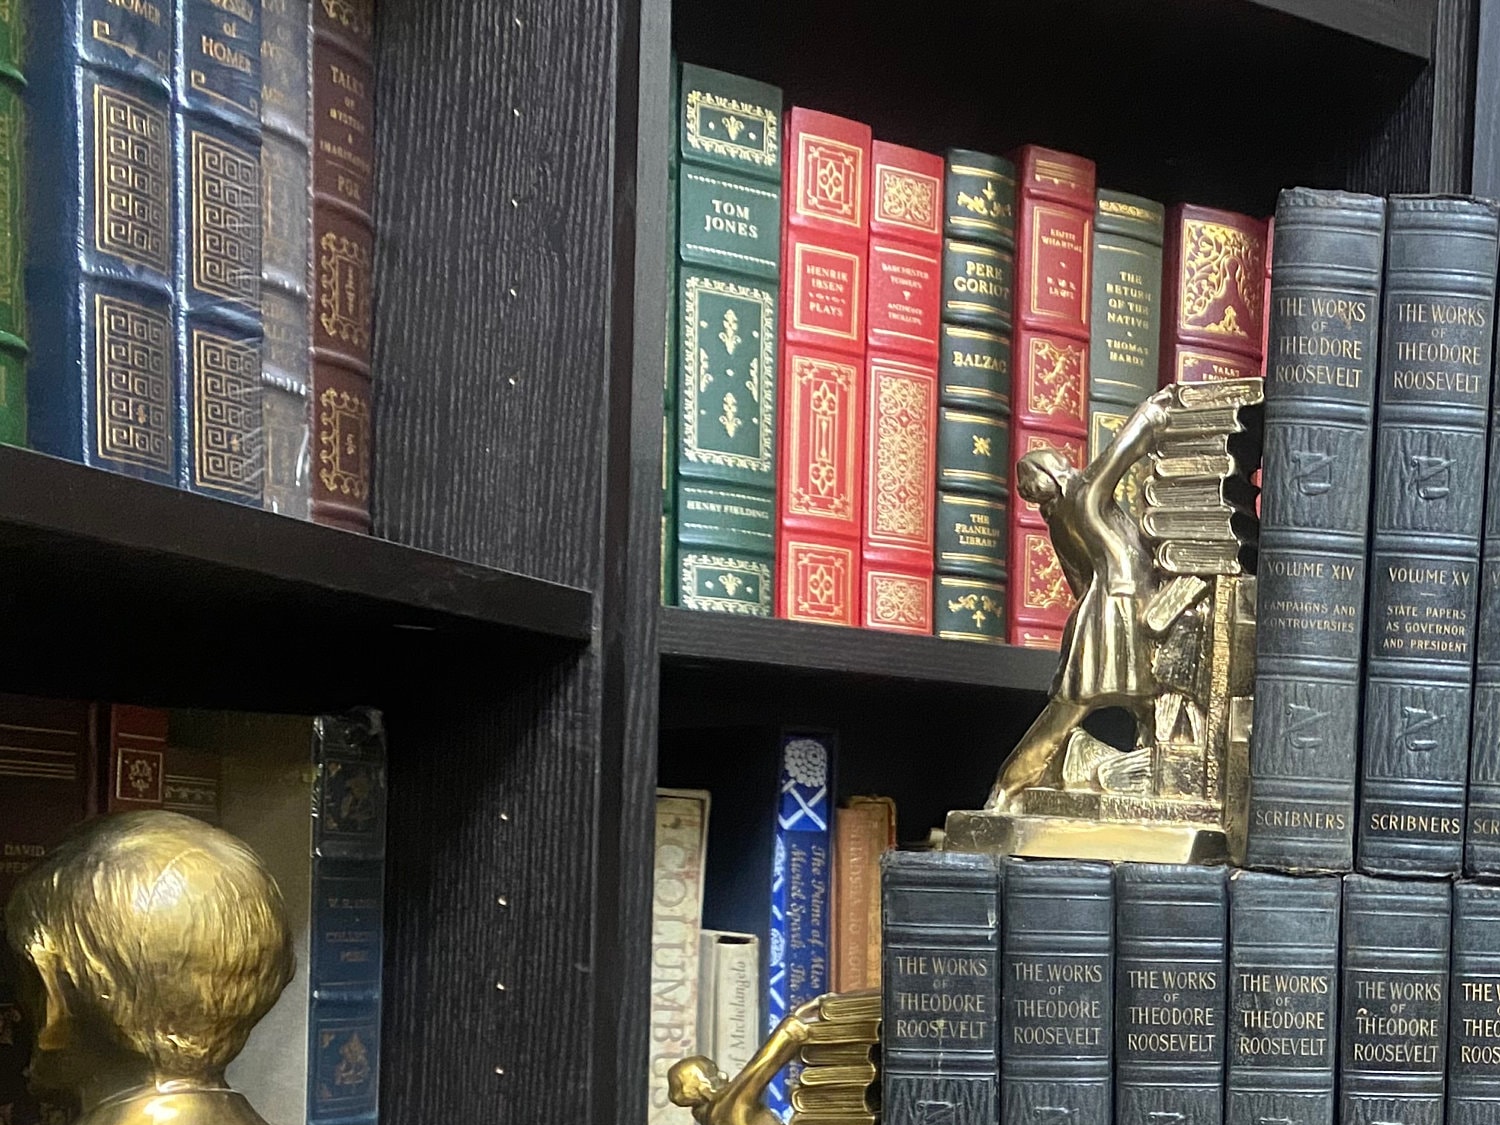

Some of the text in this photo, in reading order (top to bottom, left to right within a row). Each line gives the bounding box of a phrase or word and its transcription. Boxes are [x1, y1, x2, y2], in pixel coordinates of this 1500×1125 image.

[711, 199, 750, 220] TOM
[704, 214, 759, 239] JONES
[806, 264, 849, 281] HENRIK
[965, 260, 1003, 280] PERE
[1119, 270, 1143, 286] THE
[811, 278, 845, 293] IBSEN
[953, 275, 1010, 298] GORIOT
[1106, 282, 1151, 302] RETURN
[809, 301, 844, 317] PLAYS
[1108, 299, 1149, 316] OF THE
[1397, 303, 1486, 328] THE WORKS
[1107, 312, 1149, 330] NATIVE
[1431, 327, 1446, 338] OF
[1105, 338, 1149, 356] THOMAS
[1395, 340, 1482, 366] THEODORE
[953, 350, 1008, 374] BALZAC
[1109, 351, 1145, 367] HARDY
[1393, 369, 1482, 395] ROOSEVELT
[686, 500, 769, 520] HENRY FIELDING
[969, 513, 990, 524] THE
[959, 534, 997, 548] LIBRARY
[1388, 567, 1470, 587] VOLUME XV
[1386, 604, 1467, 620] STATE PAPERS
[1385, 621, 1466, 636] AS GOVERNOR
[1383, 638, 1469, 654] AND PRESIDENT
[1370, 812, 1461, 835] SCRIBNERS
[811, 844, 826, 877] The
[786, 843, 807, 950] Muriel Spark
[810, 879, 825, 927] Prime
[810, 950, 825, 989] Miss
[1462, 982, 1493, 1001] THE
[729, 960, 752, 1053] Michelangelo
